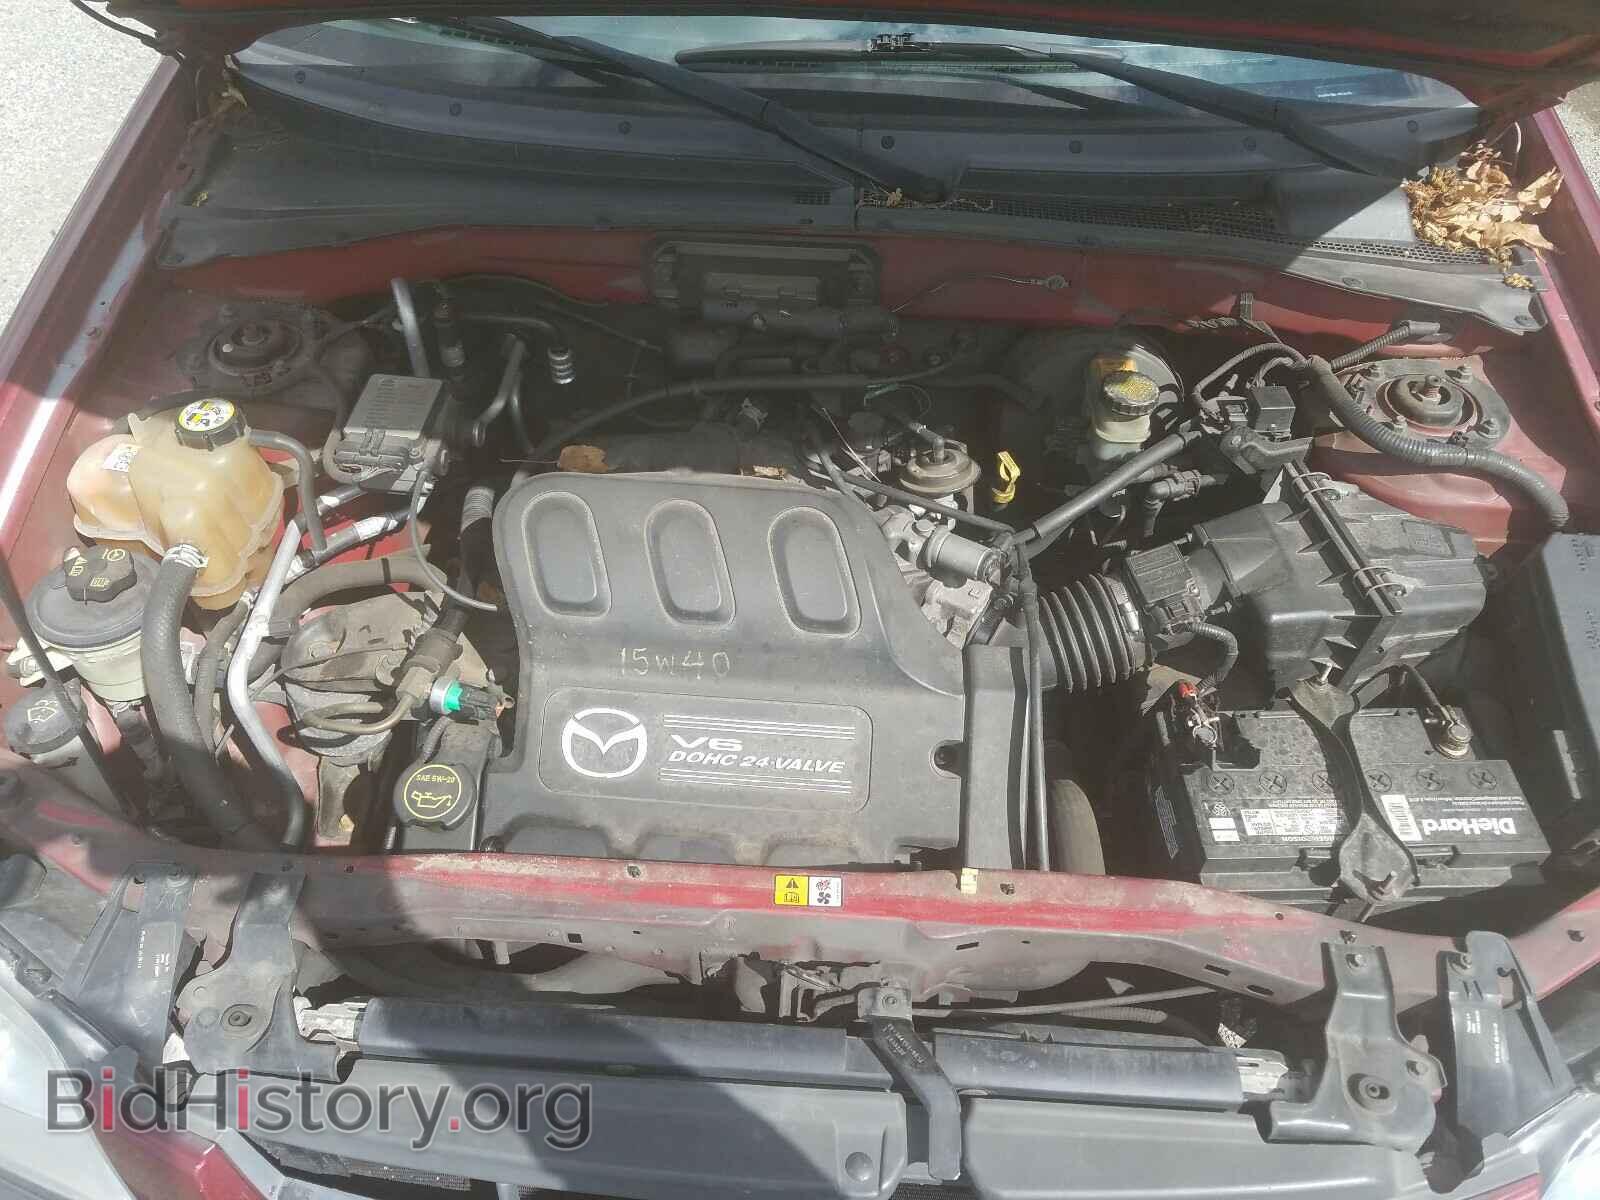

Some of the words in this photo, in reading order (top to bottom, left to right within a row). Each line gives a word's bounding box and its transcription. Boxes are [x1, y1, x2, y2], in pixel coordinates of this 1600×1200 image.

[670, 734, 743, 752] V6
[668, 750, 738, 767] DOHC
[774, 757, 846, 774] VALVE
[1421, 817, 1517, 835] DieHard
